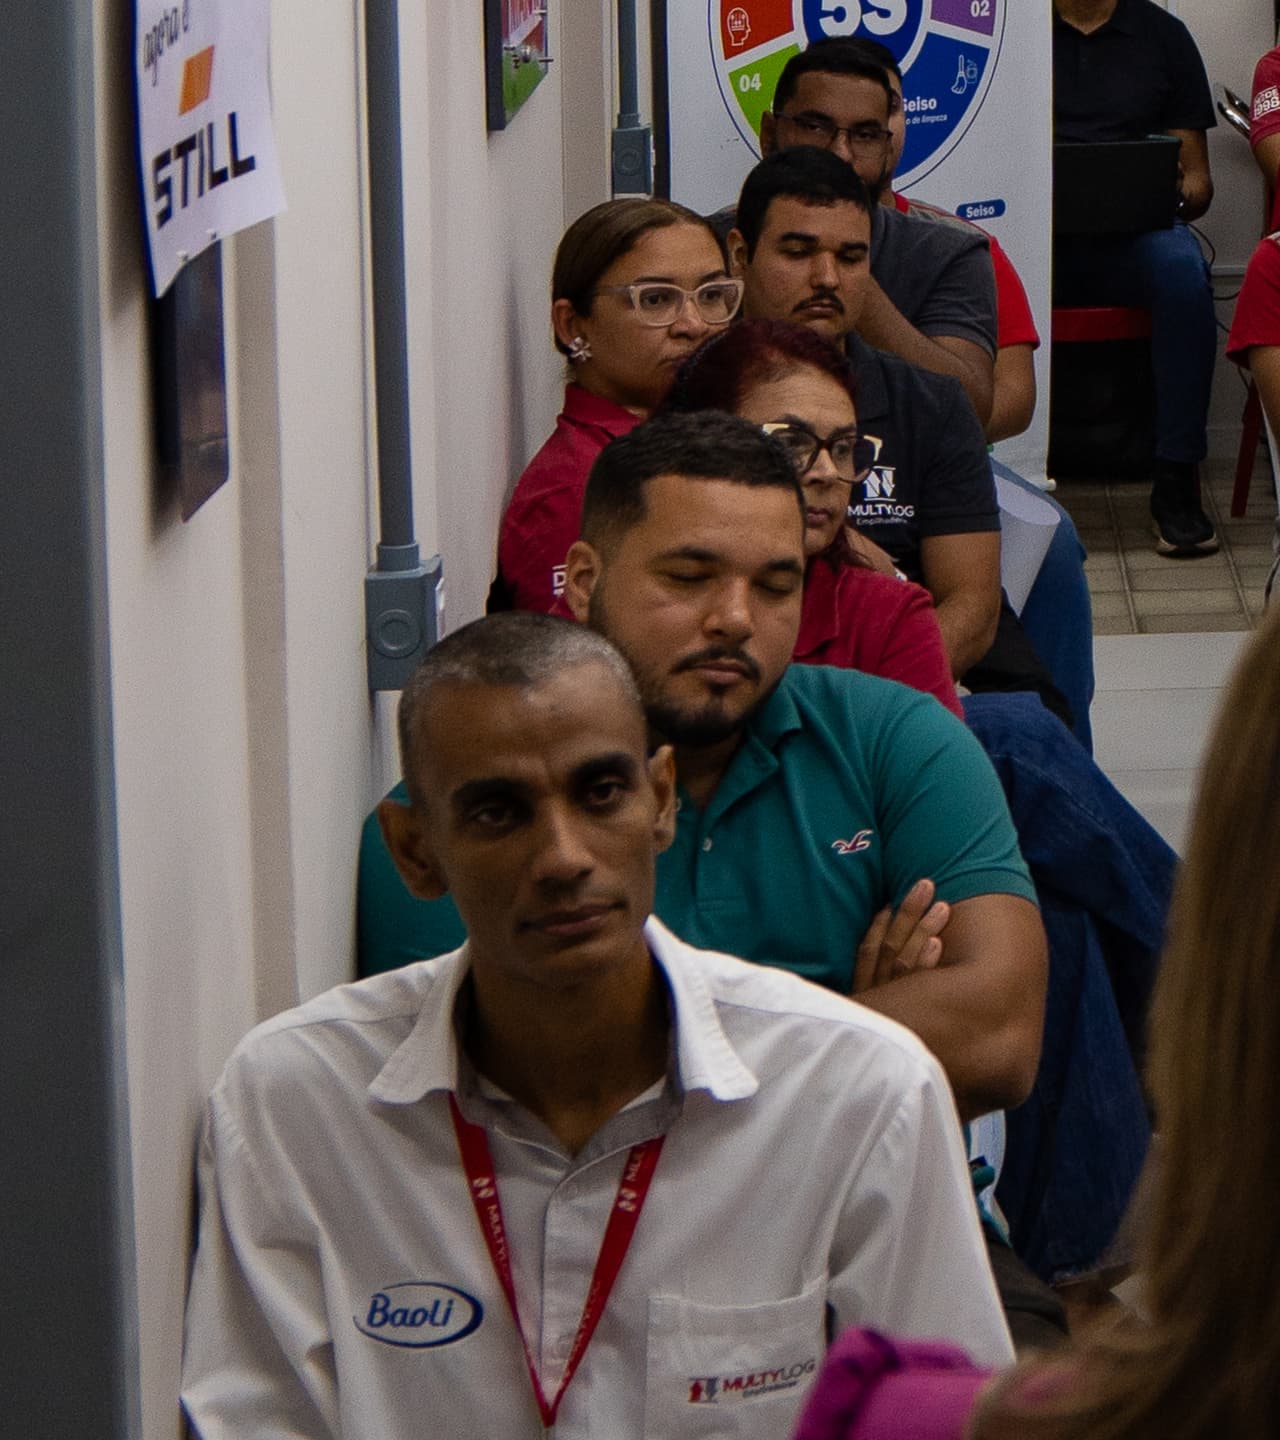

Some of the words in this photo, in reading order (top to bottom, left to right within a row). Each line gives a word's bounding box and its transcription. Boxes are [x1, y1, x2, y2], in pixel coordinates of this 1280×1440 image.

[970, 0, 990, 18] 02
[739, 73, 762, 93] 04
[152, 110, 256, 231] STILL
[965, 205, 995, 219] Seiso
[847, 503, 915, 517] MULTYLOG
[367, 1292, 455, 1329] Baoli
[723, 1359, 816, 1393] MULTYLOG
